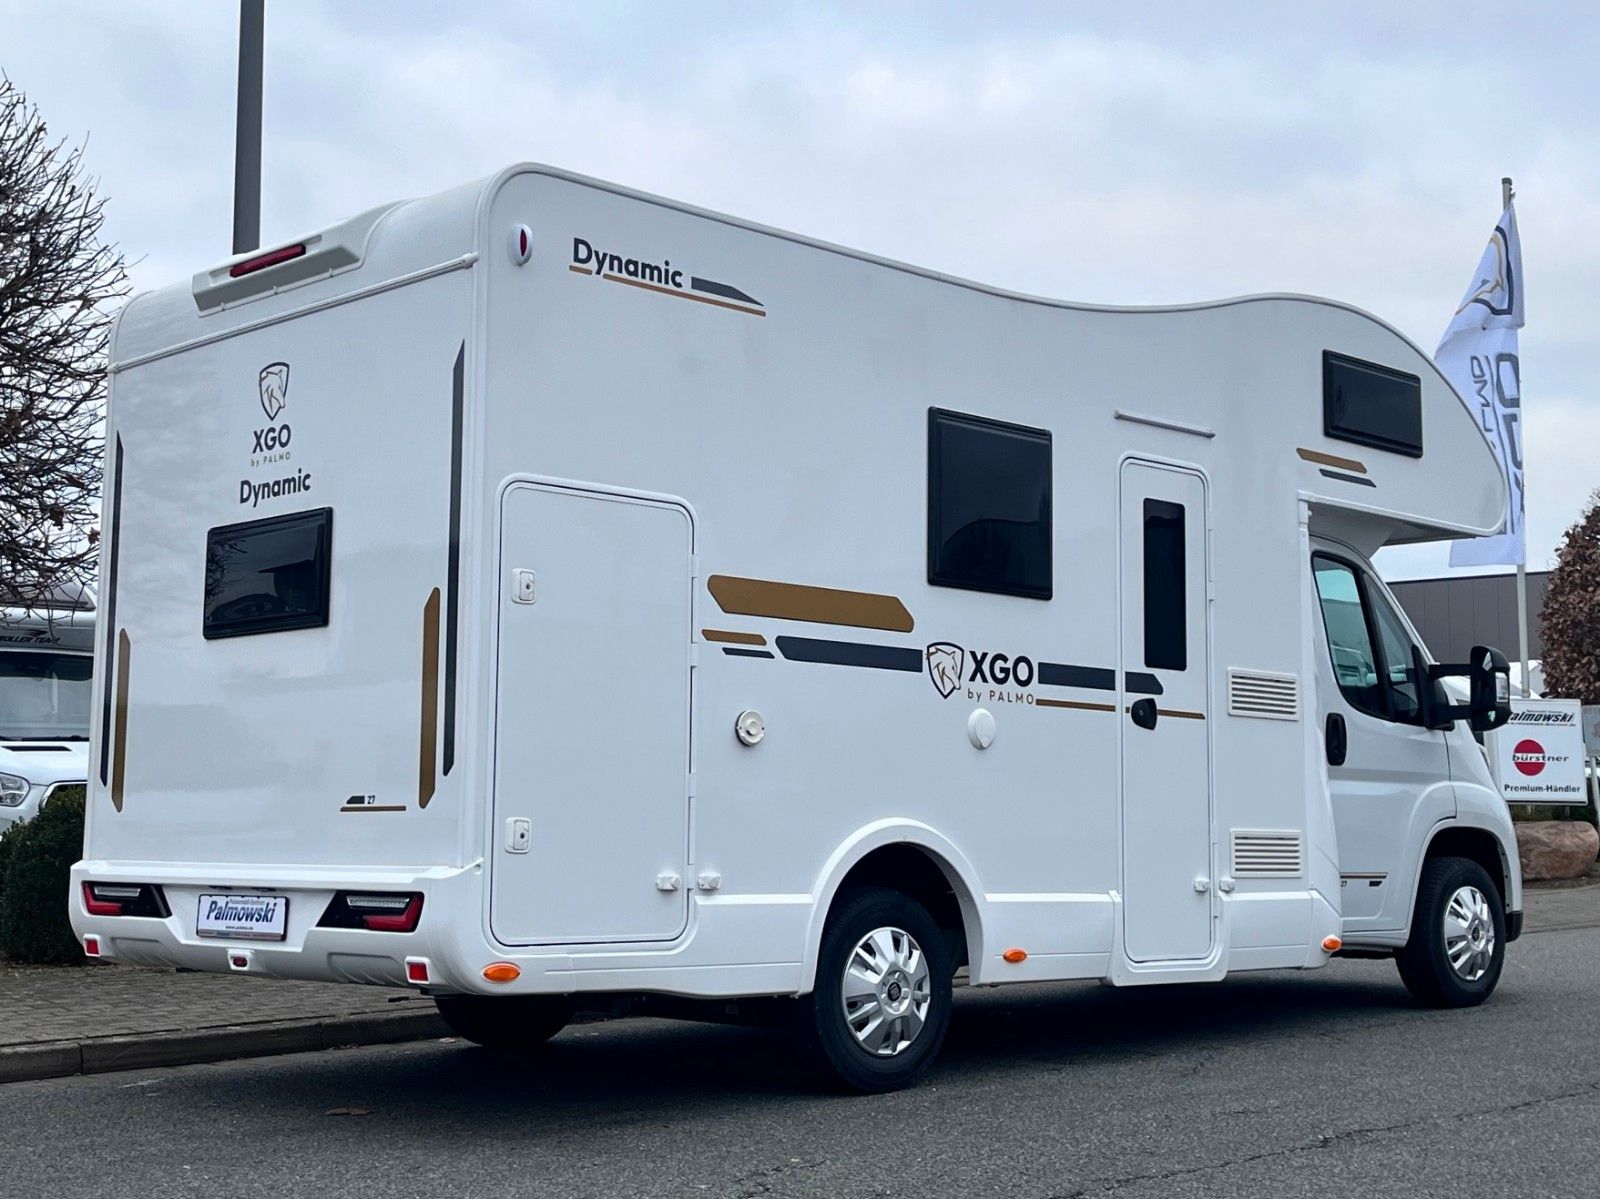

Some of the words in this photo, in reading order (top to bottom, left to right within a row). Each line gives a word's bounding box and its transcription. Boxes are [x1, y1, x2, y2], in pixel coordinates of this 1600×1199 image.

[573, 237, 683, 288] Dynamic
[252, 424, 292, 454] XGO
[251, 458, 260, 468] by
[263, 451, 292, 465] PALMO
[239, 467, 311, 508] Dynamic
[968, 650, 1034, 688] XGO
[967, 688, 982, 703] by
[989, 689, 1035, 705] PALMO
[1509, 711, 1576, 723] almowski
[1512, 753, 1570, 763] bürstner
[1504, 783, 1581, 793] Premium-Händler
[367, 795, 376, 805] 27
[206, 900, 277, 923] Palmowski
